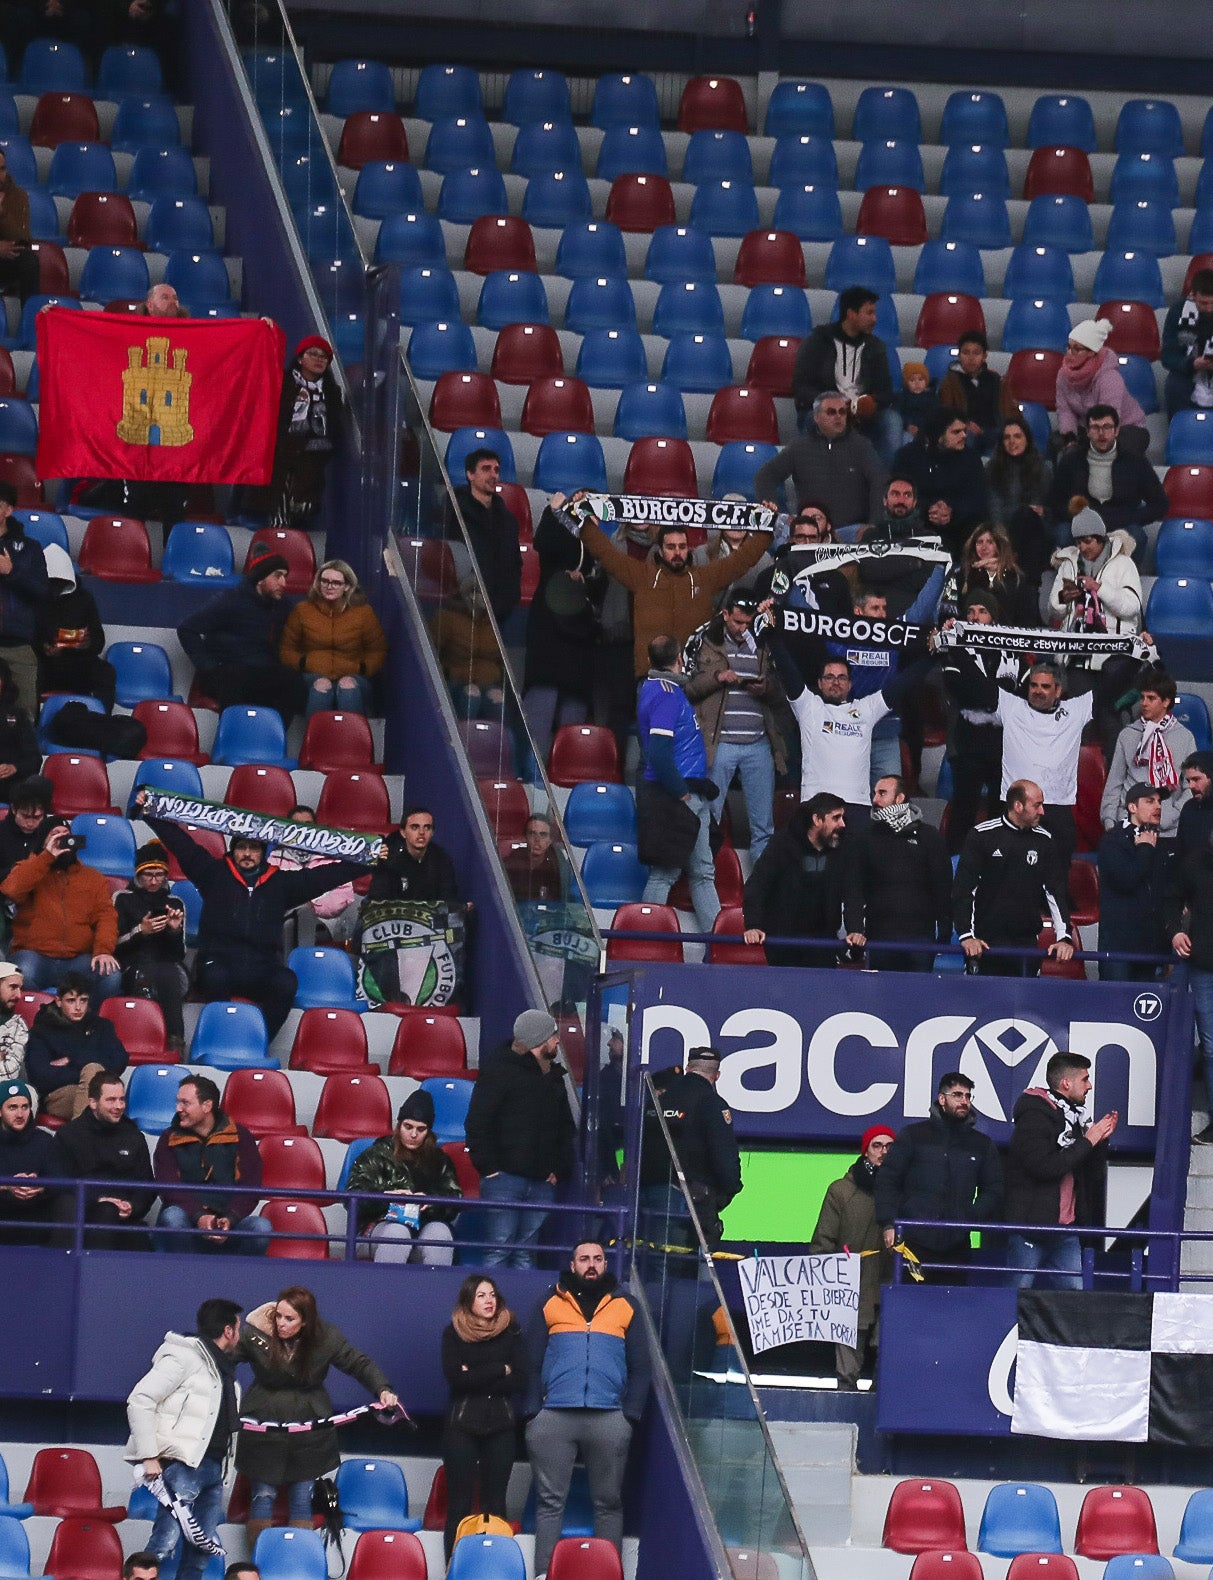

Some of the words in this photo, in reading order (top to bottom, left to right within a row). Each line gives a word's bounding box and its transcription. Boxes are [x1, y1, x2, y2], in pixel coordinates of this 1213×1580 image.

[622, 498, 706, 524] BURGOS
[711, 504, 747, 525] C.F.
[259, 819, 275, 839] Y
[372, 923, 413, 941] CLUB
[434, 952, 453, 1007] FUTBO
[1138, 999, 1158, 1014] 17
[741, 1256, 851, 1294] VALCARCE
[747, 1291, 792, 1316] DESDE
[800, 1289, 821, 1306] EL
[823, 1287, 860, 1312] BIERZO
[777, 1308, 803, 1324] DAS
[810, 1308, 830, 1321] TU
[755, 1321, 825, 1351] CAMISETA
